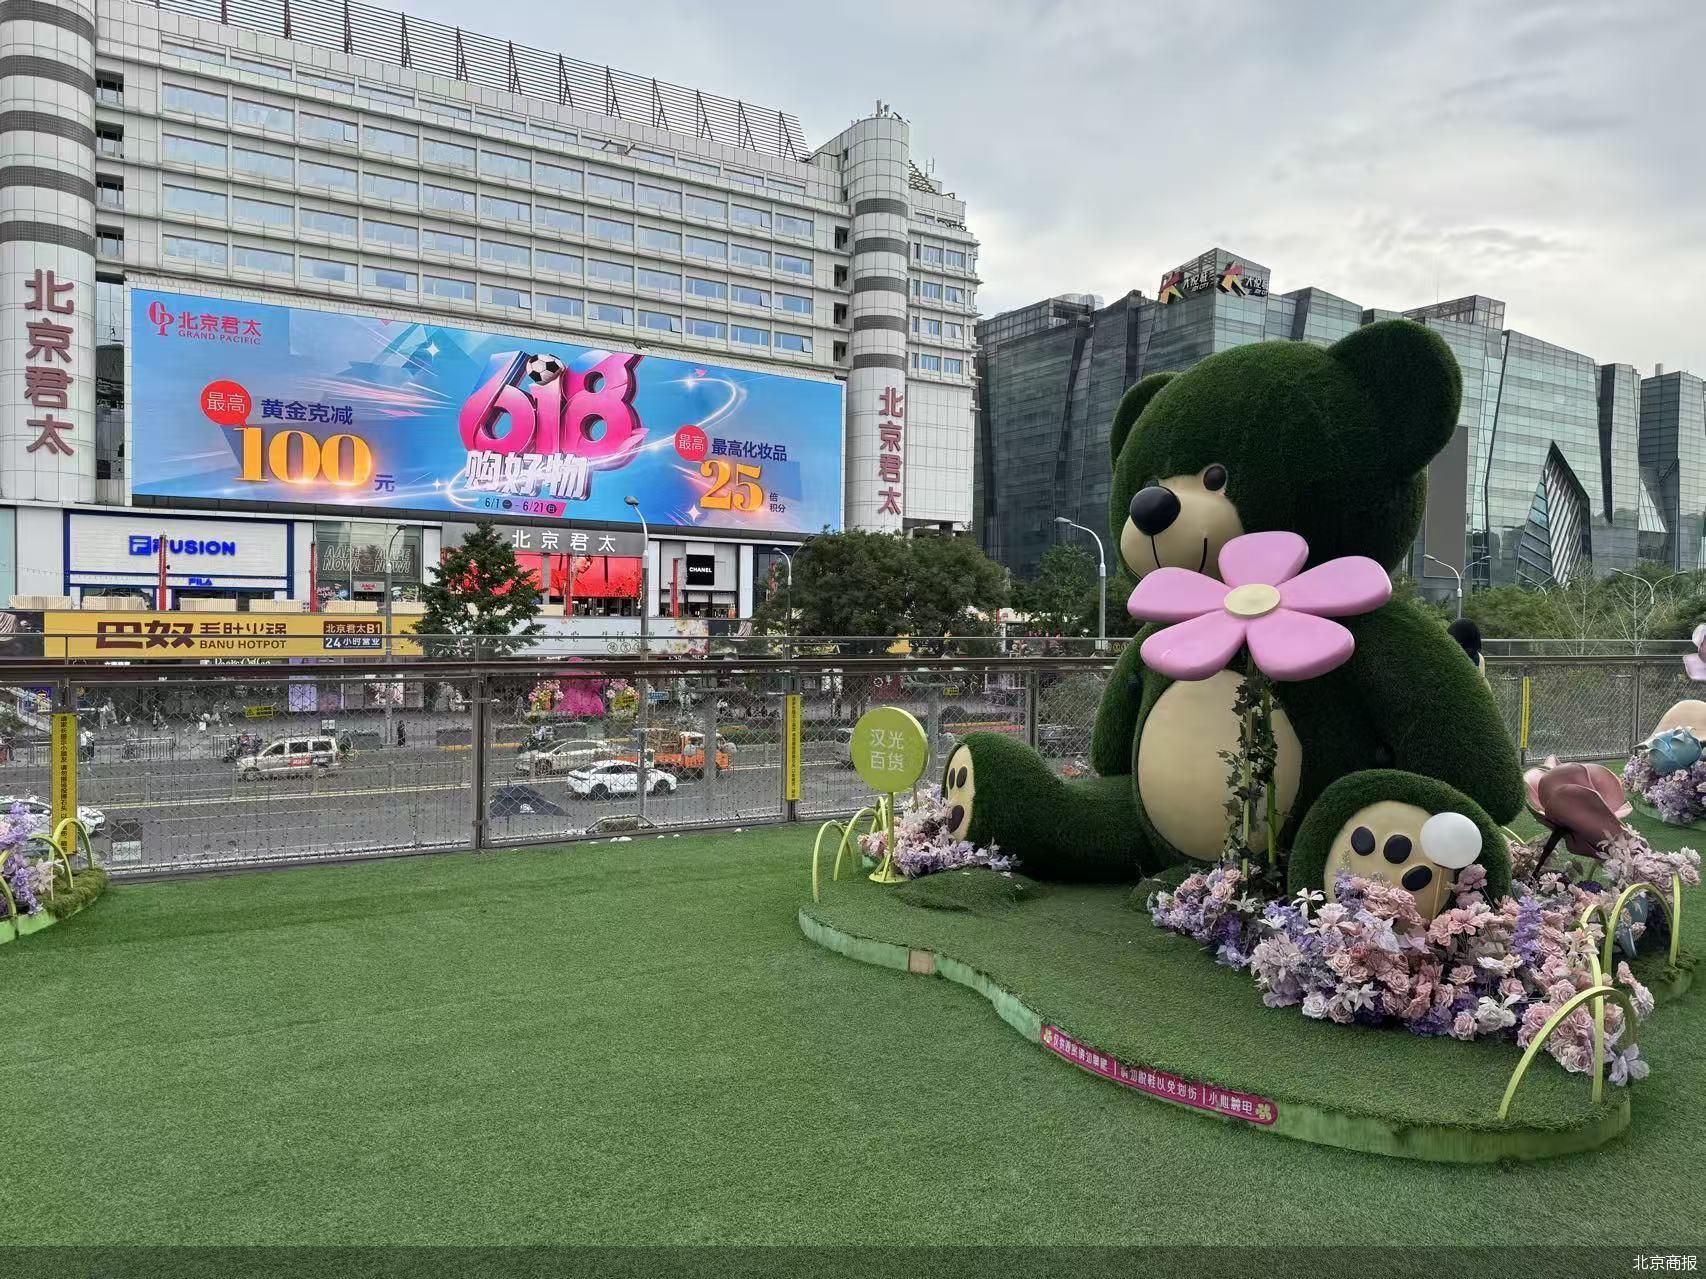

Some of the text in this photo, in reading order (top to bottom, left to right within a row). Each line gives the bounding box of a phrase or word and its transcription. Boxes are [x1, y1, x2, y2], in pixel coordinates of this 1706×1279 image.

[178, 311, 262, 337] 北京君太
[178, 330, 262, 345] GRAND PACIFIC
[24, 268, 74, 456] 北京君太
[206, 391, 246, 414] 最高
[260, 398, 354, 425] 黄金克减
[458, 350, 648, 471] 618
[678, 433, 706, 452] 最高
[711, 437, 788, 462] 最高化妆品
[878, 386, 905, 516] 北京君太
[231, 426, 374, 487] 100
[374, 474, 396, 493] 元
[699, 459, 765, 512] 25
[484, 498, 501, 509] 6/1
[522, 502, 545, 514] 6/21
[511, 529, 617, 553] 北京君太
[322, 558, 361, 572] NOW!
[96, 620, 195, 649] 巴奴
[325, 623, 381, 634] 北京君太B1
[200, 640, 287, 649] BANU HOTPOT
[870, 729, 904, 750] 汉光
[870, 751, 904, 773] 百货
